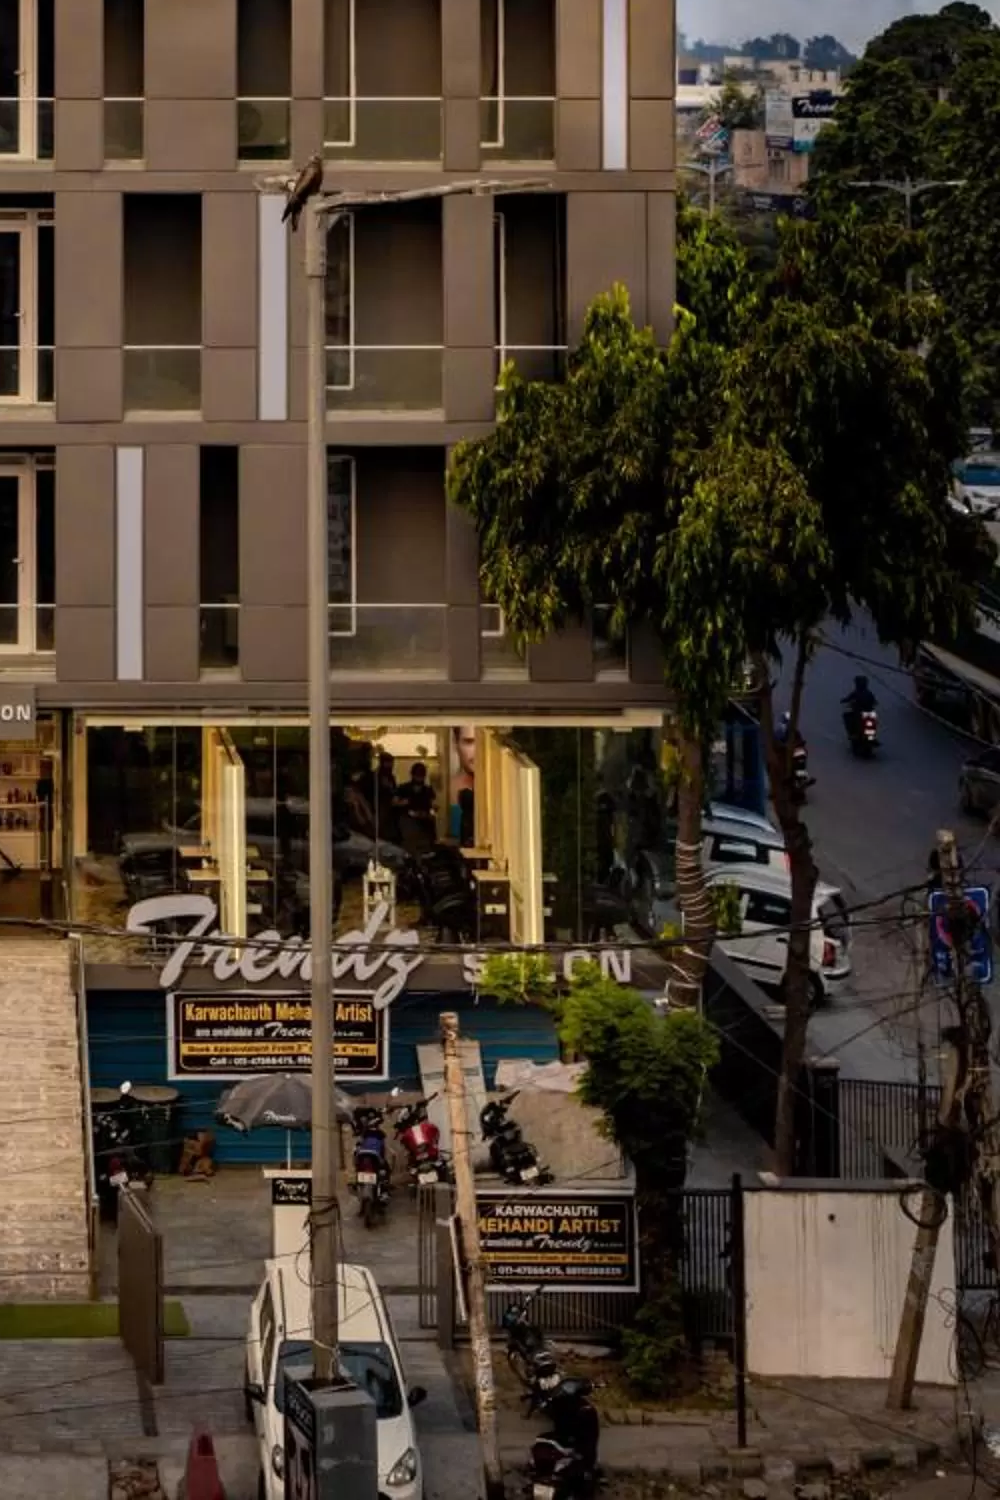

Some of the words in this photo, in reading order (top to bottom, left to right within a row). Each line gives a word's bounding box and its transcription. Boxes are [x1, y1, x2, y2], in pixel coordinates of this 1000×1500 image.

[185, 1002, 272, 1021] Karwachauth
[276, 1002, 313, 1021] Meha
[336, 1003, 373, 1022] Artist
[212, 1025, 252, 1037] available
[209, 1057, 226, 1065] Call
[495, 1205, 598, 1217] KARWACHAUTH
[558, 1219, 621, 1233] ARTIST
